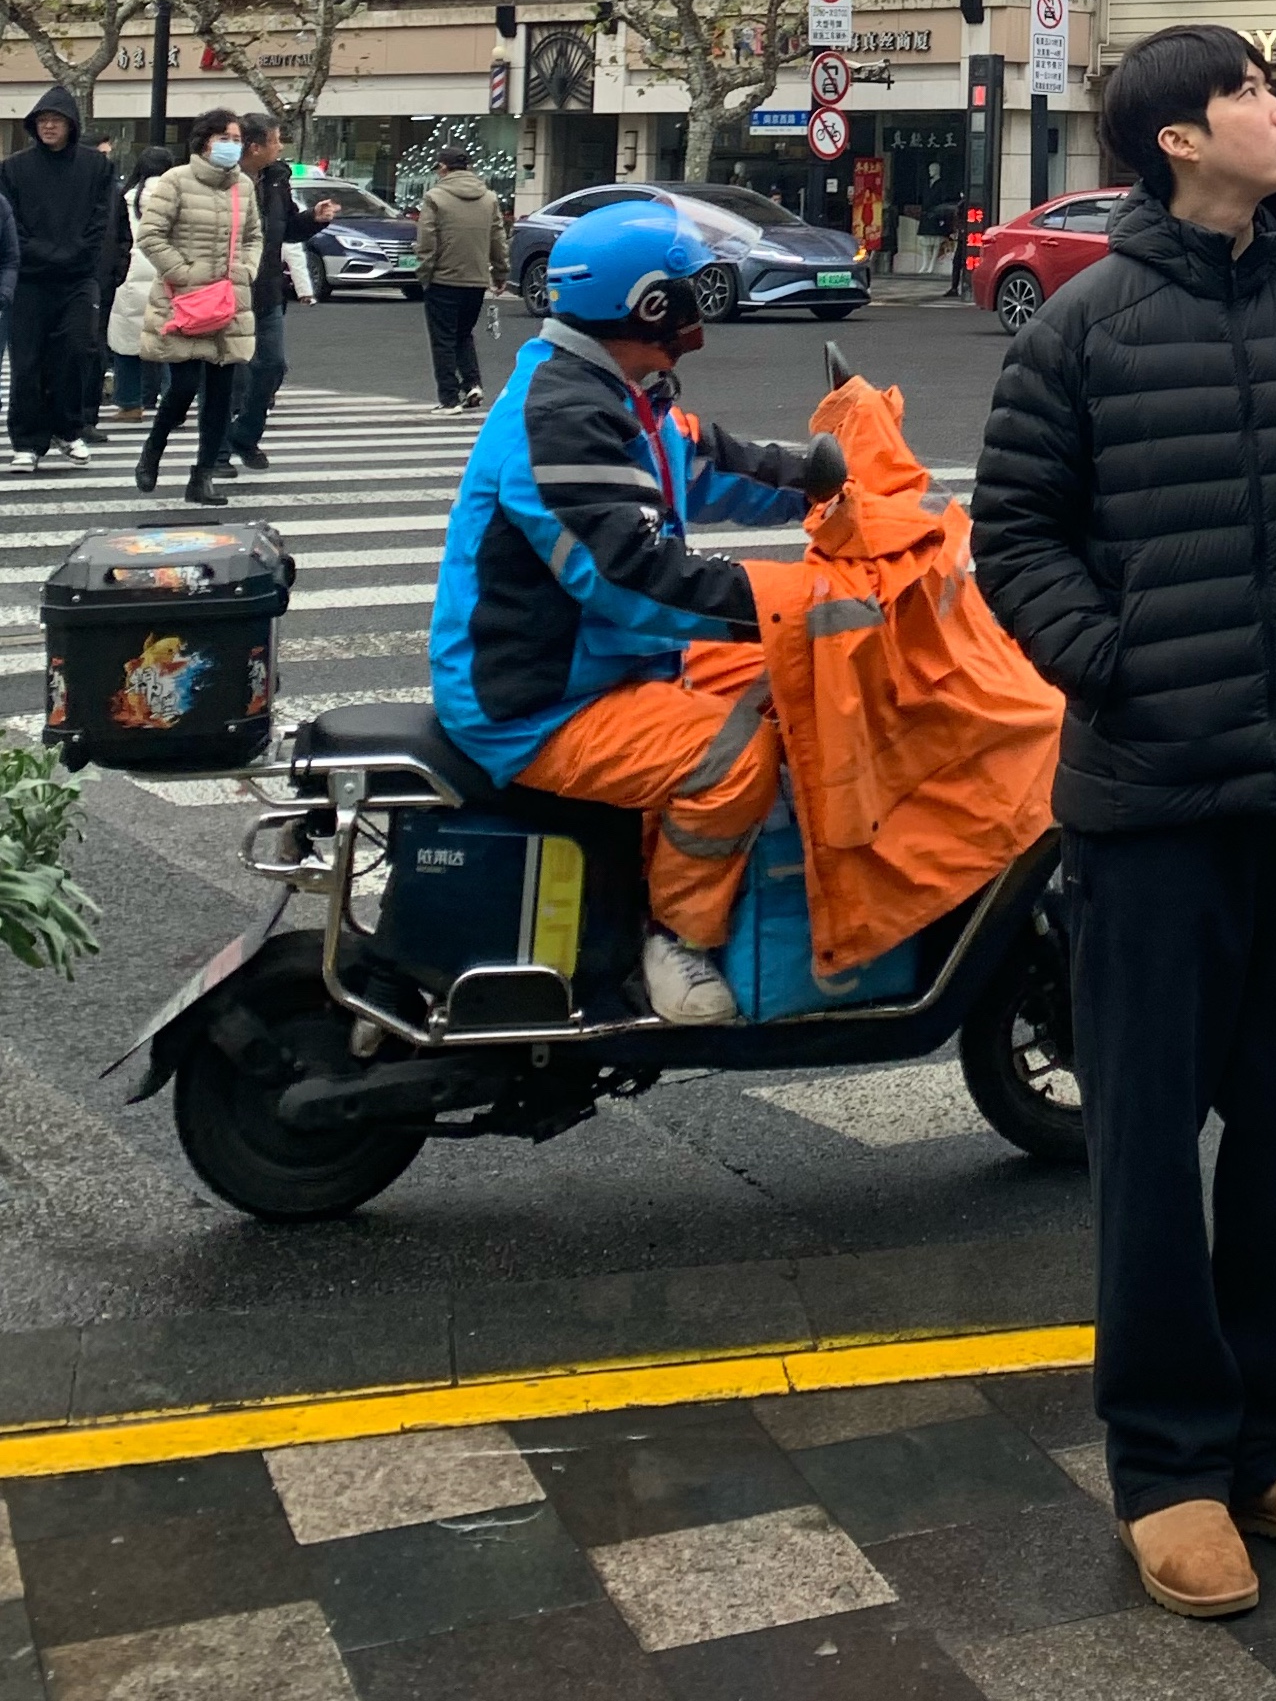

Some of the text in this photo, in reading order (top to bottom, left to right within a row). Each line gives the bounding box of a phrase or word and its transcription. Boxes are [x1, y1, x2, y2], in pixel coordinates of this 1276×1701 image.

[832, 30, 931, 51] 海真丝商厦
